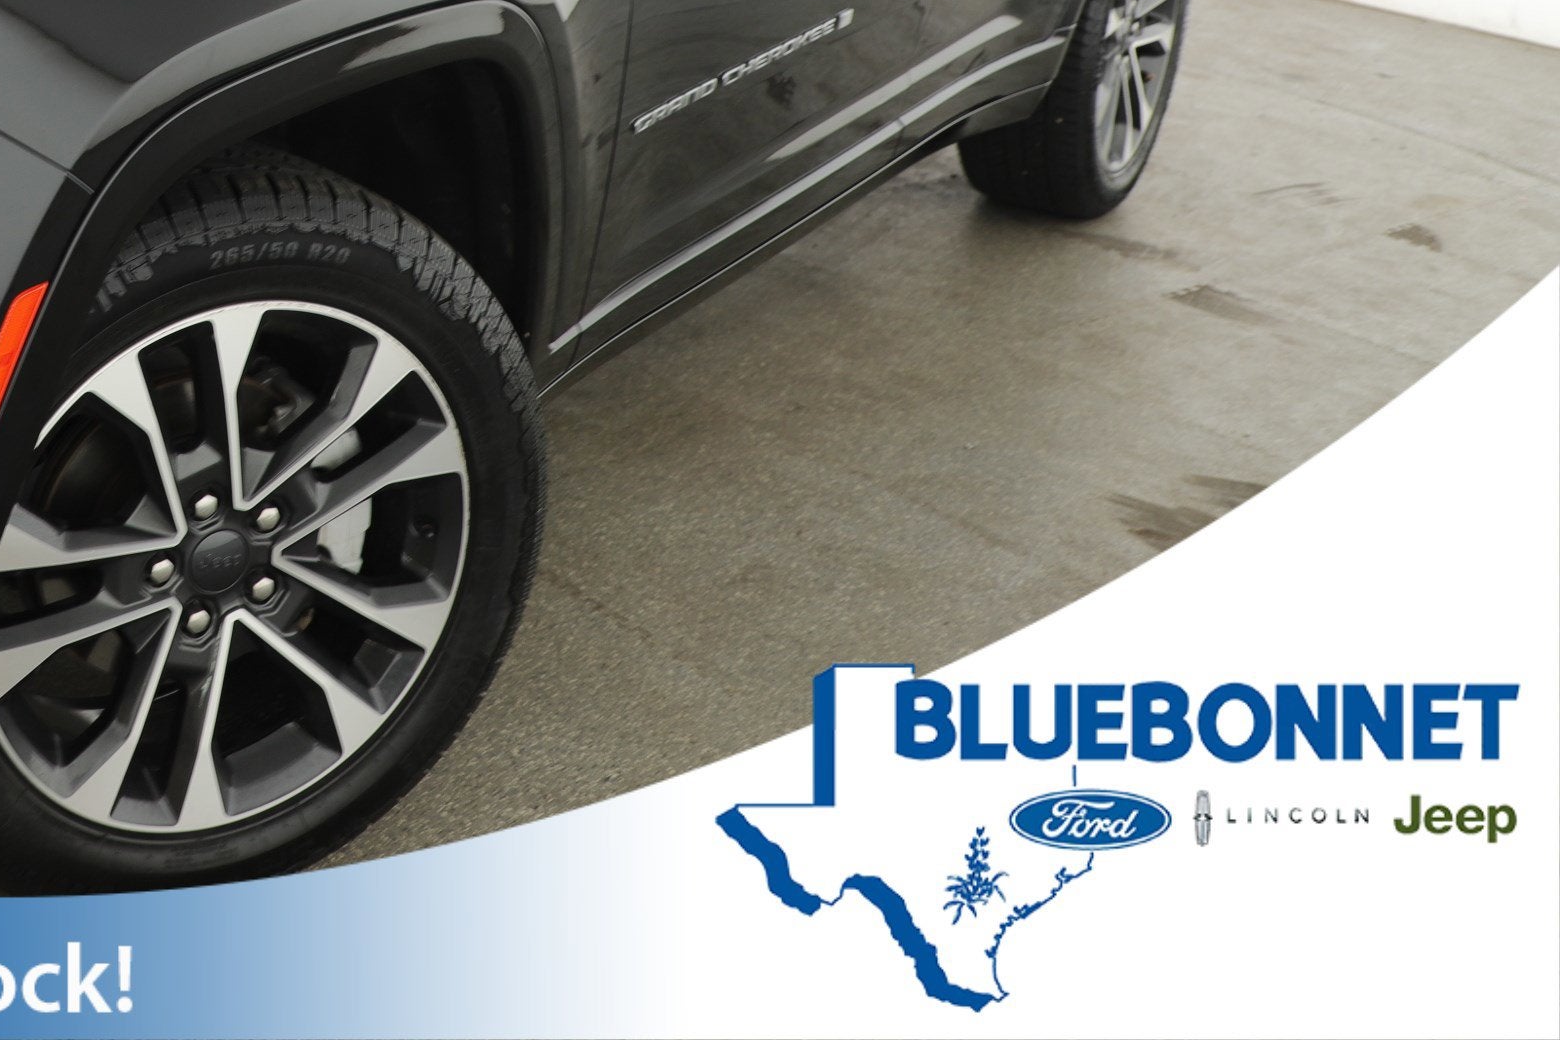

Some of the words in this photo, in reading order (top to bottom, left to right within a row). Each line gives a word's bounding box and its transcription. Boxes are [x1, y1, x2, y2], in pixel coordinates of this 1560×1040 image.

[634, 77, 719, 135] GRAND
[721, 17, 838, 87] CHEROKEE
[208, 240, 301, 270] 265/50
[305, 242, 353, 265] R20
